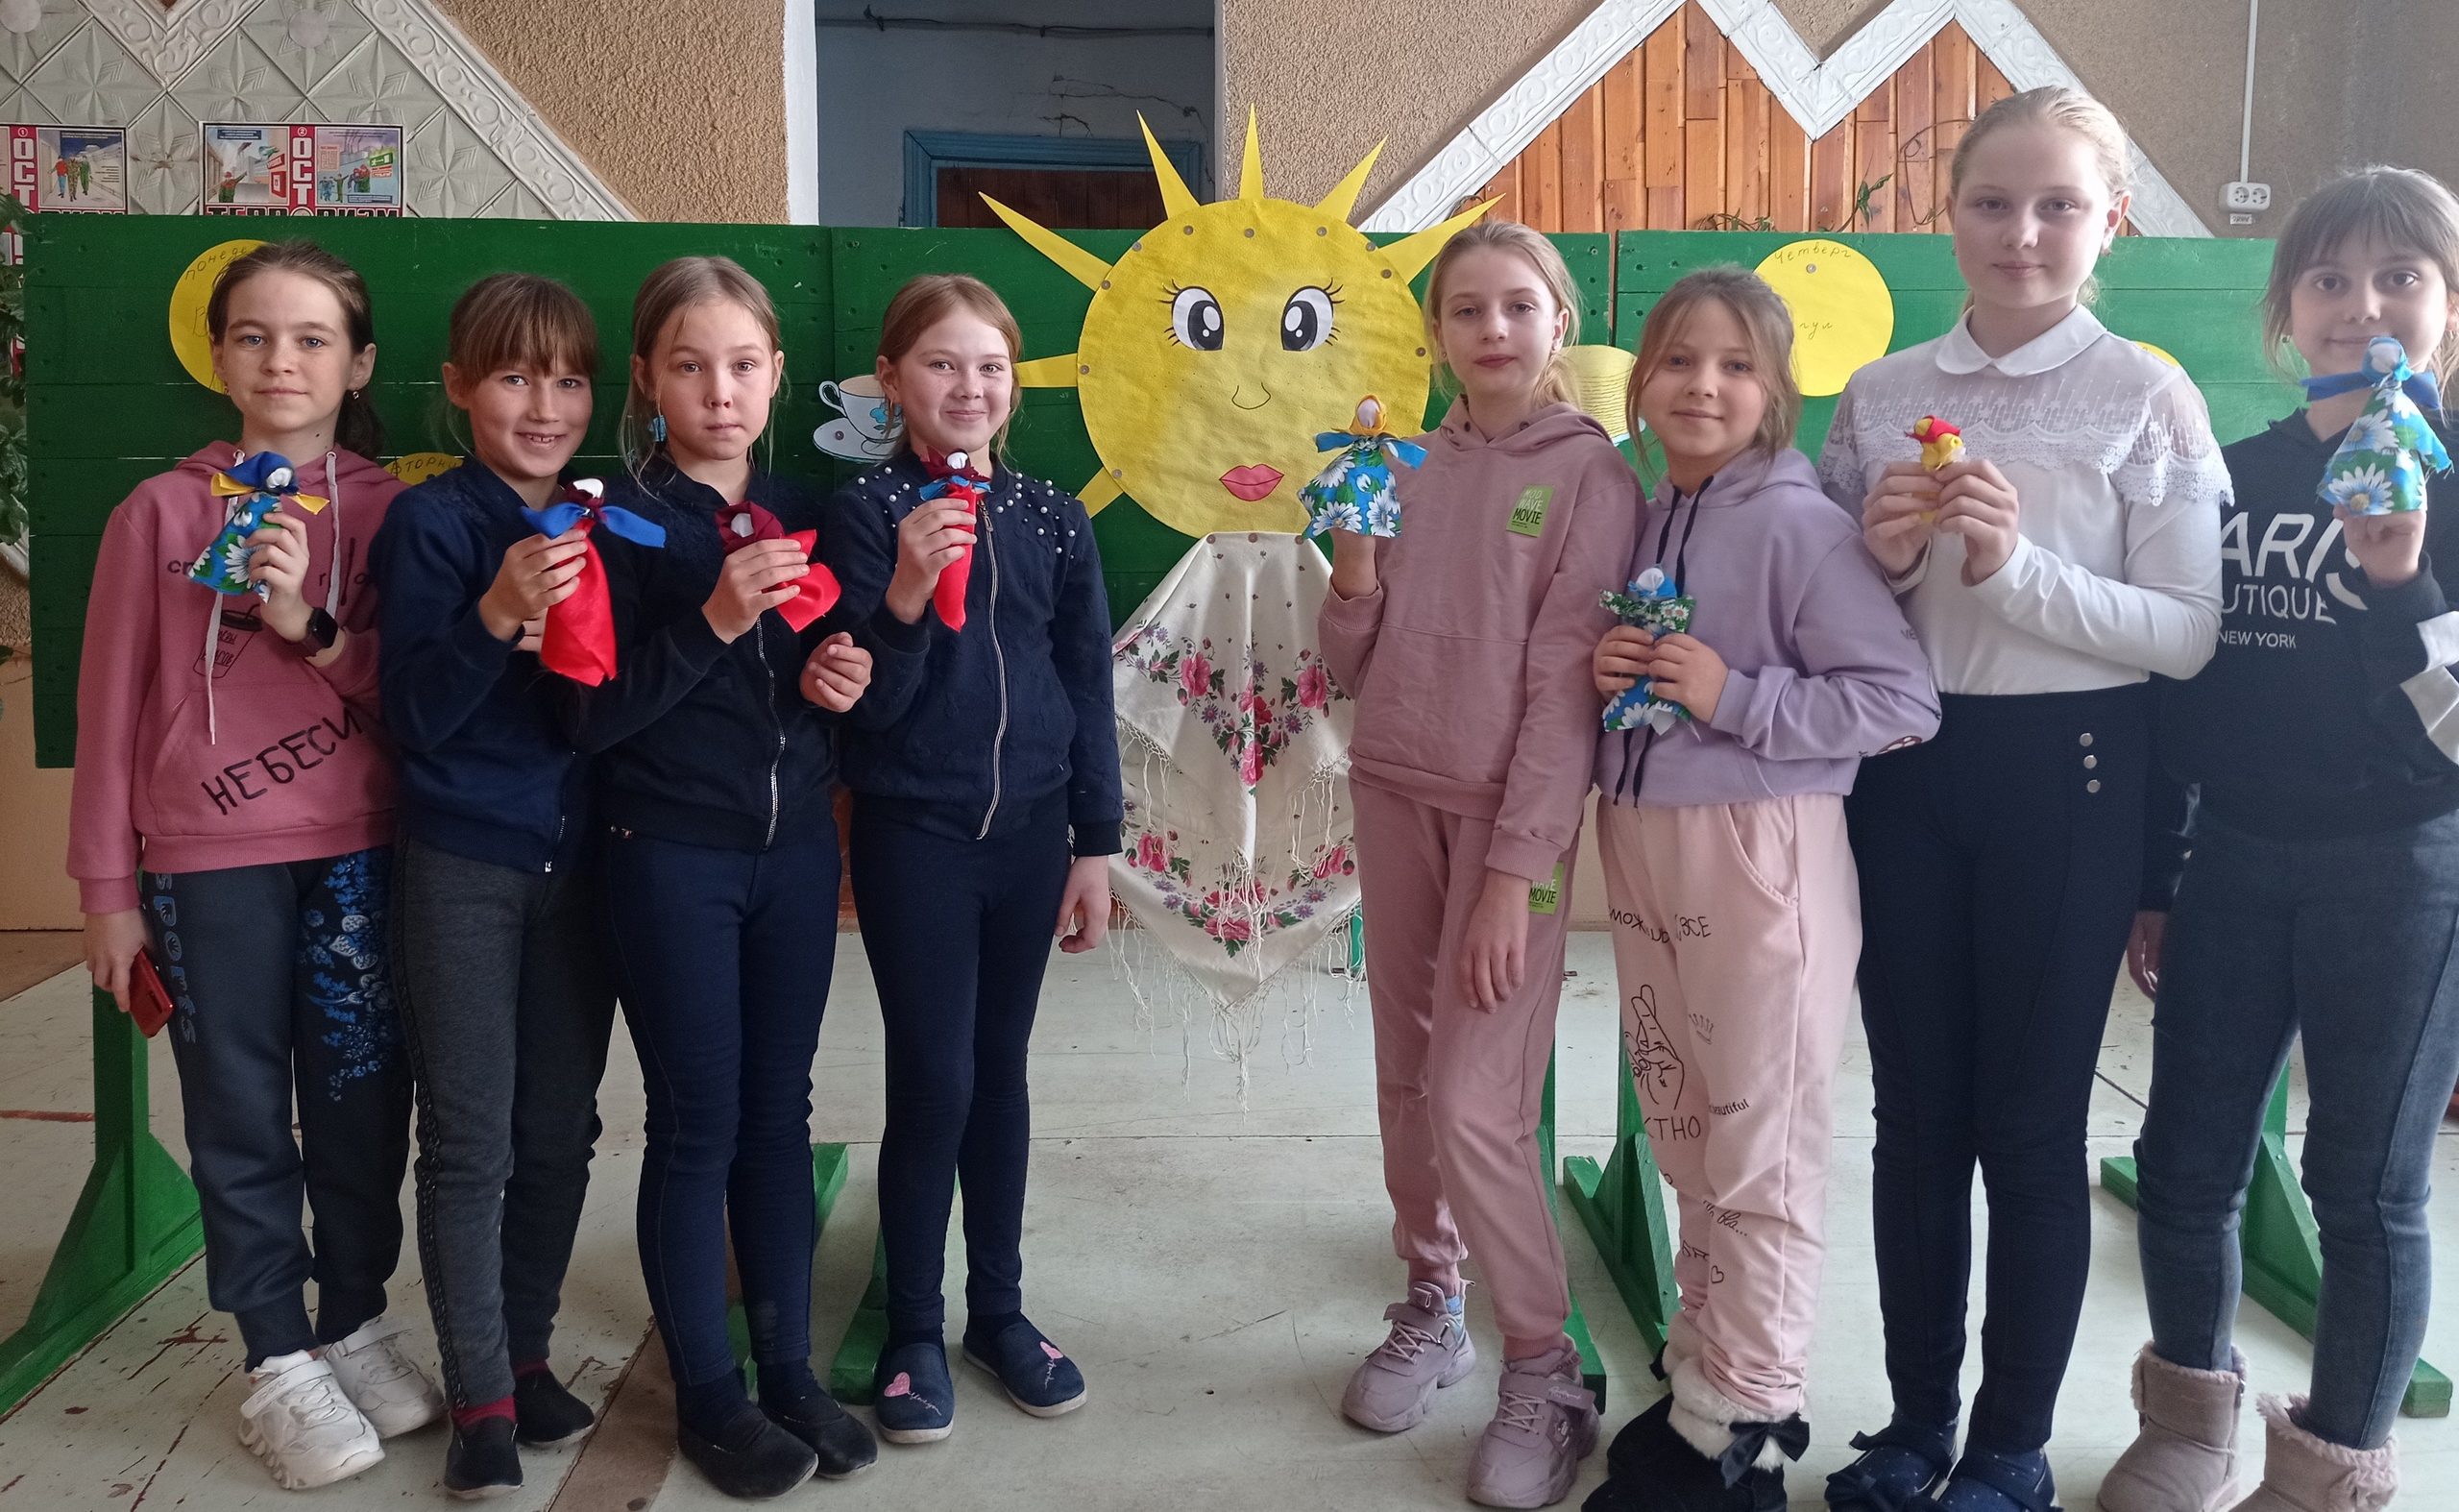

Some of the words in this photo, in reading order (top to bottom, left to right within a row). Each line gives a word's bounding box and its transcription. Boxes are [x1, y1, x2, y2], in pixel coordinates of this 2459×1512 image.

[1513, 508, 1543, 524] MOVIE
[2222, 583, 2337, 624] UTIQUE
[2218, 629, 2252, 646] NEW
[2255, 631, 2297, 648] YORK
[1528, 887, 1557, 904] MOVIE
